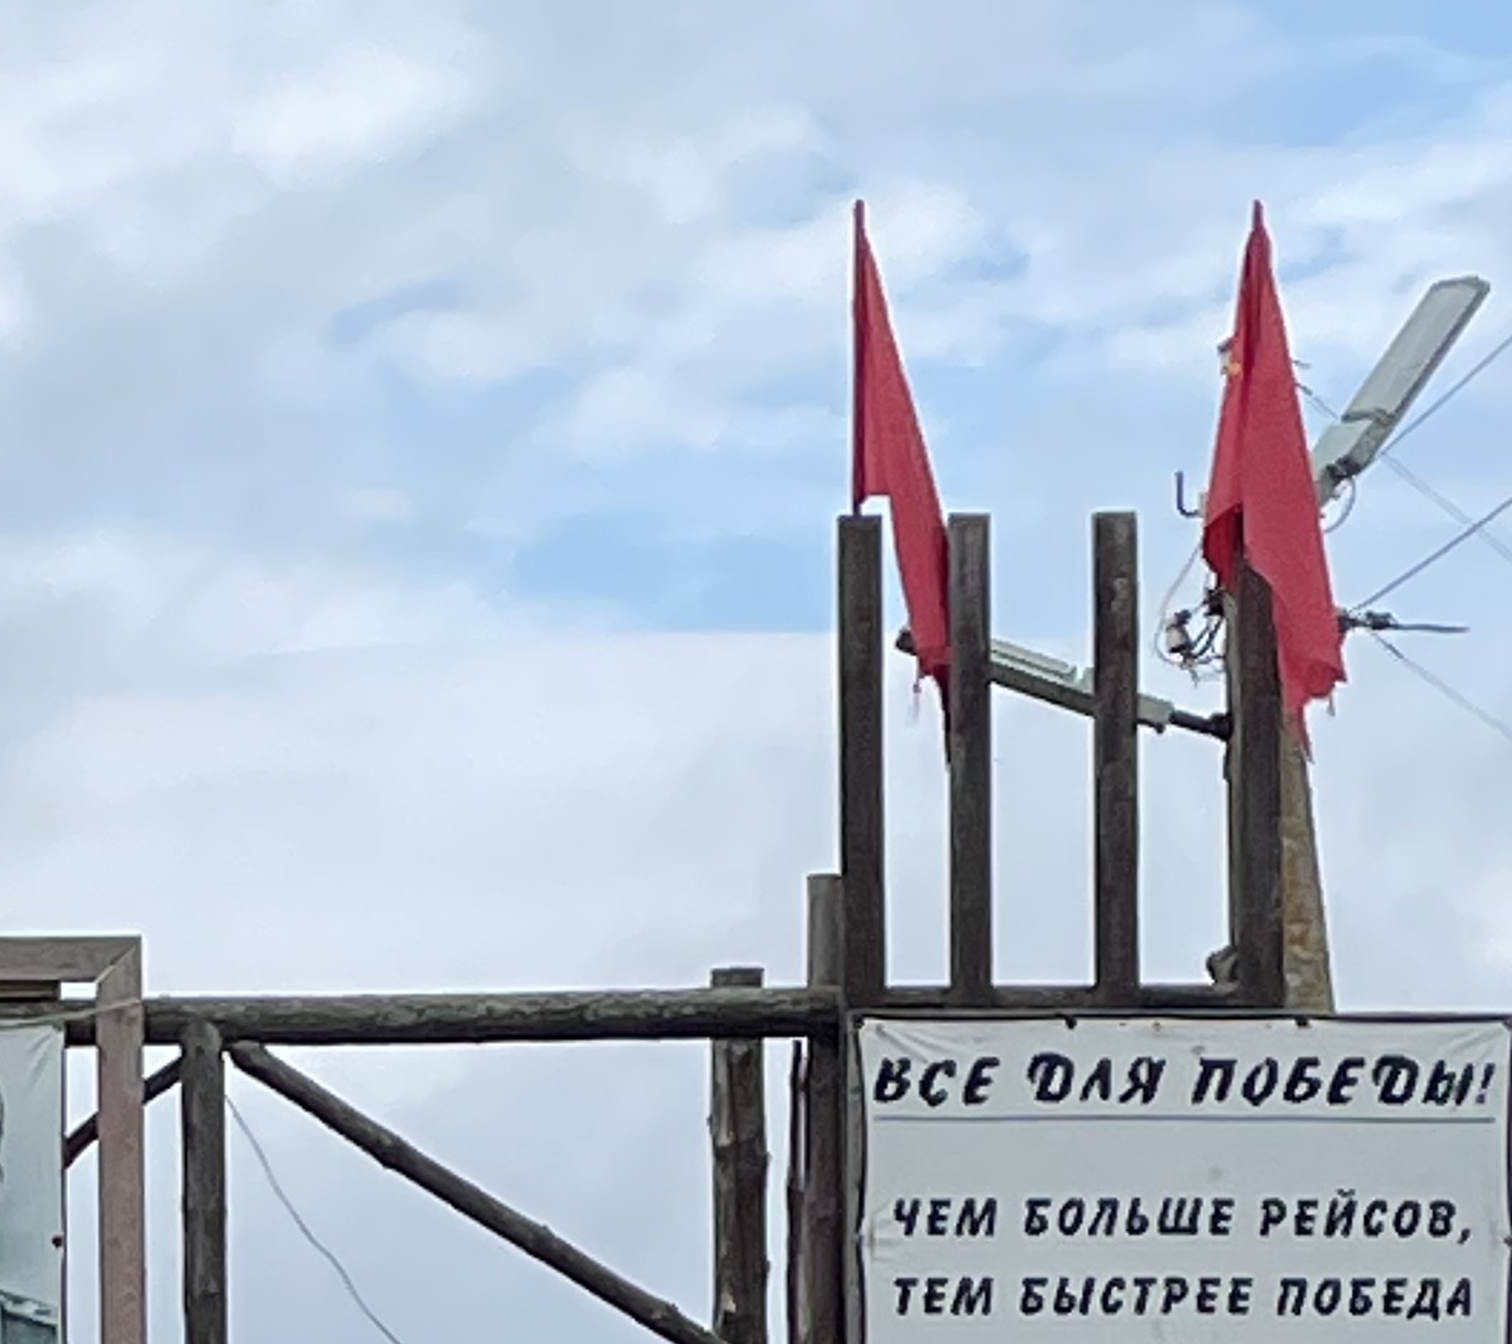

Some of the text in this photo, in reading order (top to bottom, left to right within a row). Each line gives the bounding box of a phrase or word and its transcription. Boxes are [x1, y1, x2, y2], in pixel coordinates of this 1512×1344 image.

[873, 1052, 1496, 1108] ВСЕ ДЛЯ ПОБЕДЫ!
[892, 1188, 1471, 1245] ЧЕМ БОЛЬШЕ РЕЙСОВ,
[893, 1276, 1473, 1323] ТЕМ БЫСТРЕЕ ПОБЕДА
